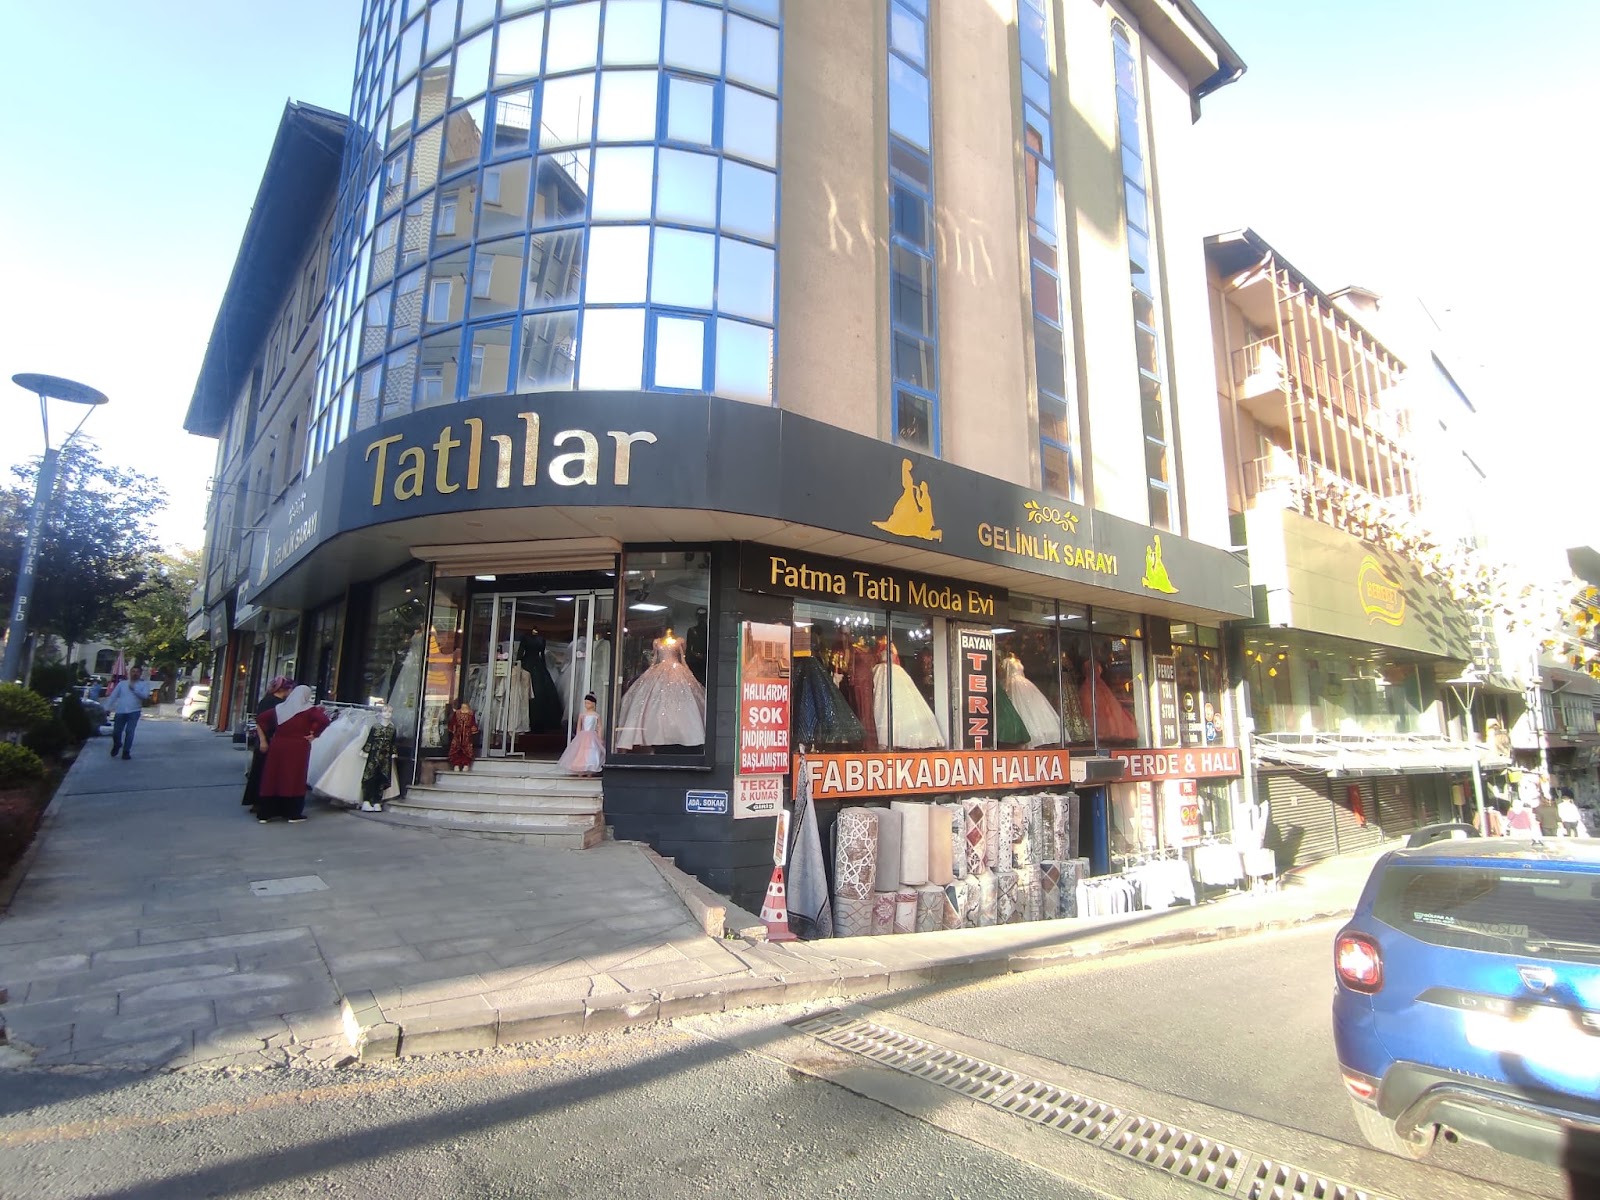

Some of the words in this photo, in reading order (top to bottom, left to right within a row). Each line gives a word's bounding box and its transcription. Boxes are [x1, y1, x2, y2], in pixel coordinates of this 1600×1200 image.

[365, 412, 658, 506] Tatlılar
[978, 522, 1060, 563] GELİNLİK
[1063, 544, 1119, 576] SARAYI
[769, 556, 846, 595] Fatma
[908, 580, 962, 611] Moda
[967, 590, 995, 616] Evi
[962, 635, 992, 651] BAYAN
[1158, 664, 1174, 679] PERDE
[743, 682, 788, 702] HALILARDA
[749, 706, 783, 727] ŞOK
[742, 726, 788, 750] İNDİRİMLER
[742, 752, 788, 771] BAŞLAMIŞTIR
[992, 755, 1064, 784] HALKA
[1117, 753, 1179, 776] PERDE
[1184, 752, 1196, 774] &
[1201, 752, 1237, 772] HALI
[703, 799, 725, 807] SOKAK
[740, 792, 747, 801] &
[749, 791, 779, 801] KUMAŞ
